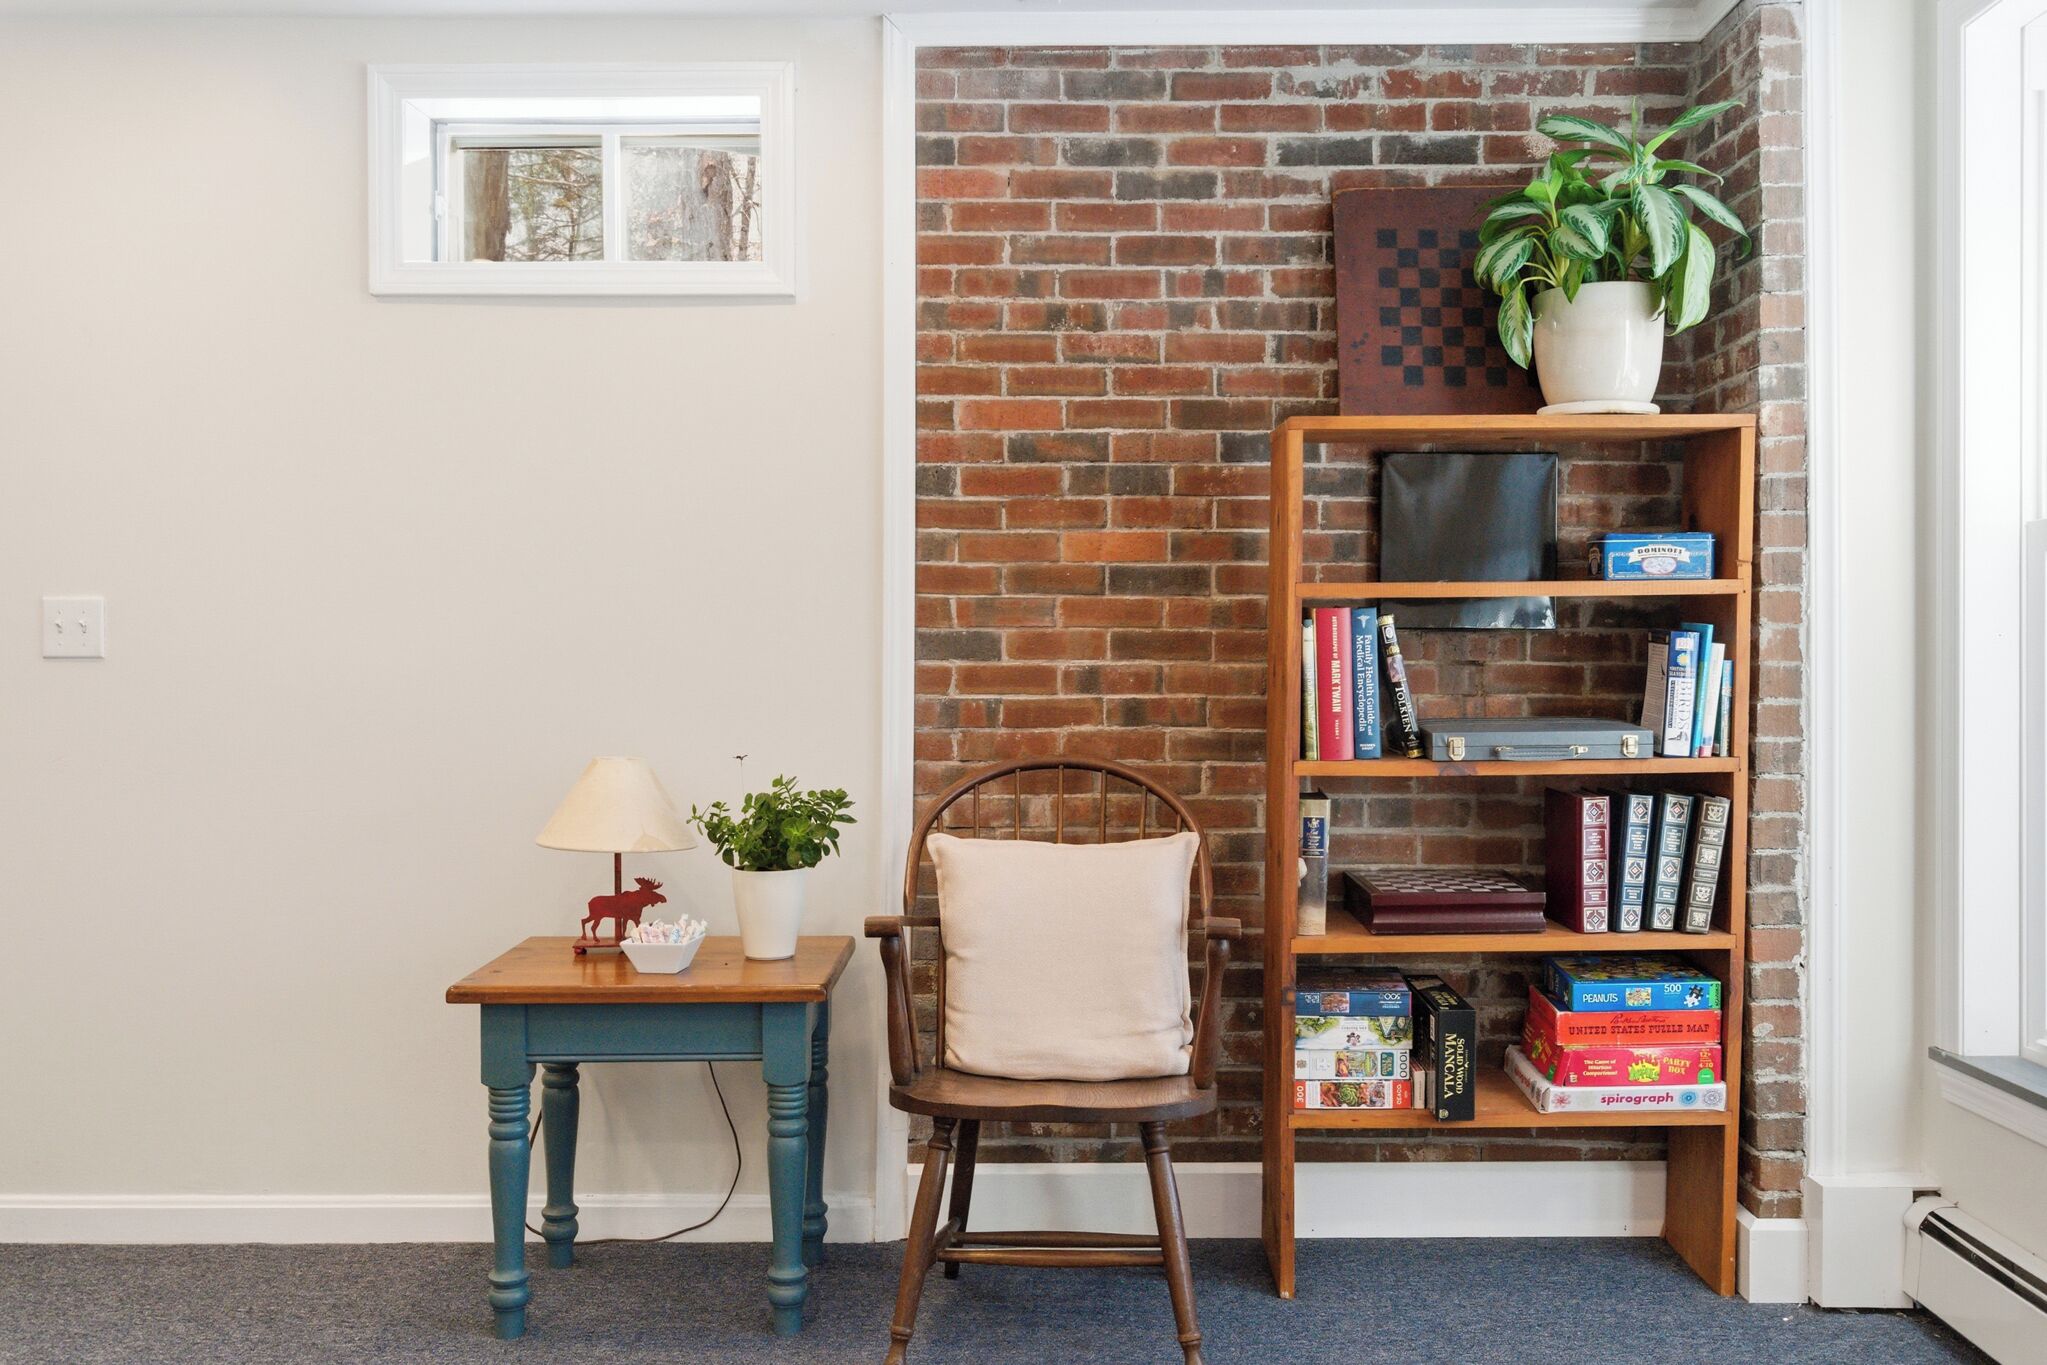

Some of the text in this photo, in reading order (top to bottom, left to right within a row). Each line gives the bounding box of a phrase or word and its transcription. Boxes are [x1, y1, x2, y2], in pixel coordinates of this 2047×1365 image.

[1363, 634, 1373, 665] Family
[1330, 659, 1340, 685] MARK
[1356, 635, 1367, 732] Medical Encyclopedia
[1364, 666, 1374, 696] Health
[1331, 686, 1341, 712] TWAIN
[1366, 697, 1376, 724] Guide
[1395, 685, 1412, 733] TOLKIEN
[1678, 681, 1692, 730] BIRDS
[1582, 993, 1618, 1003] PEANUTS
[1664, 984, 1682, 993] 500
[1568, 1024, 1710, 1035] UNITED STATES PUZZLE MAP
[1399, 1051, 1408, 1078] 1000
[1444, 1033, 1457, 1099] MANCALA
[1455, 1038, 1465, 1094] SOLID WOOD
[1663, 1057, 1691, 1068] PARTY
[1668, 1065, 1686, 1075] BOX
[1296, 1085, 1304, 1103] 300
[1600, 1092, 1674, 1106] spirograph
